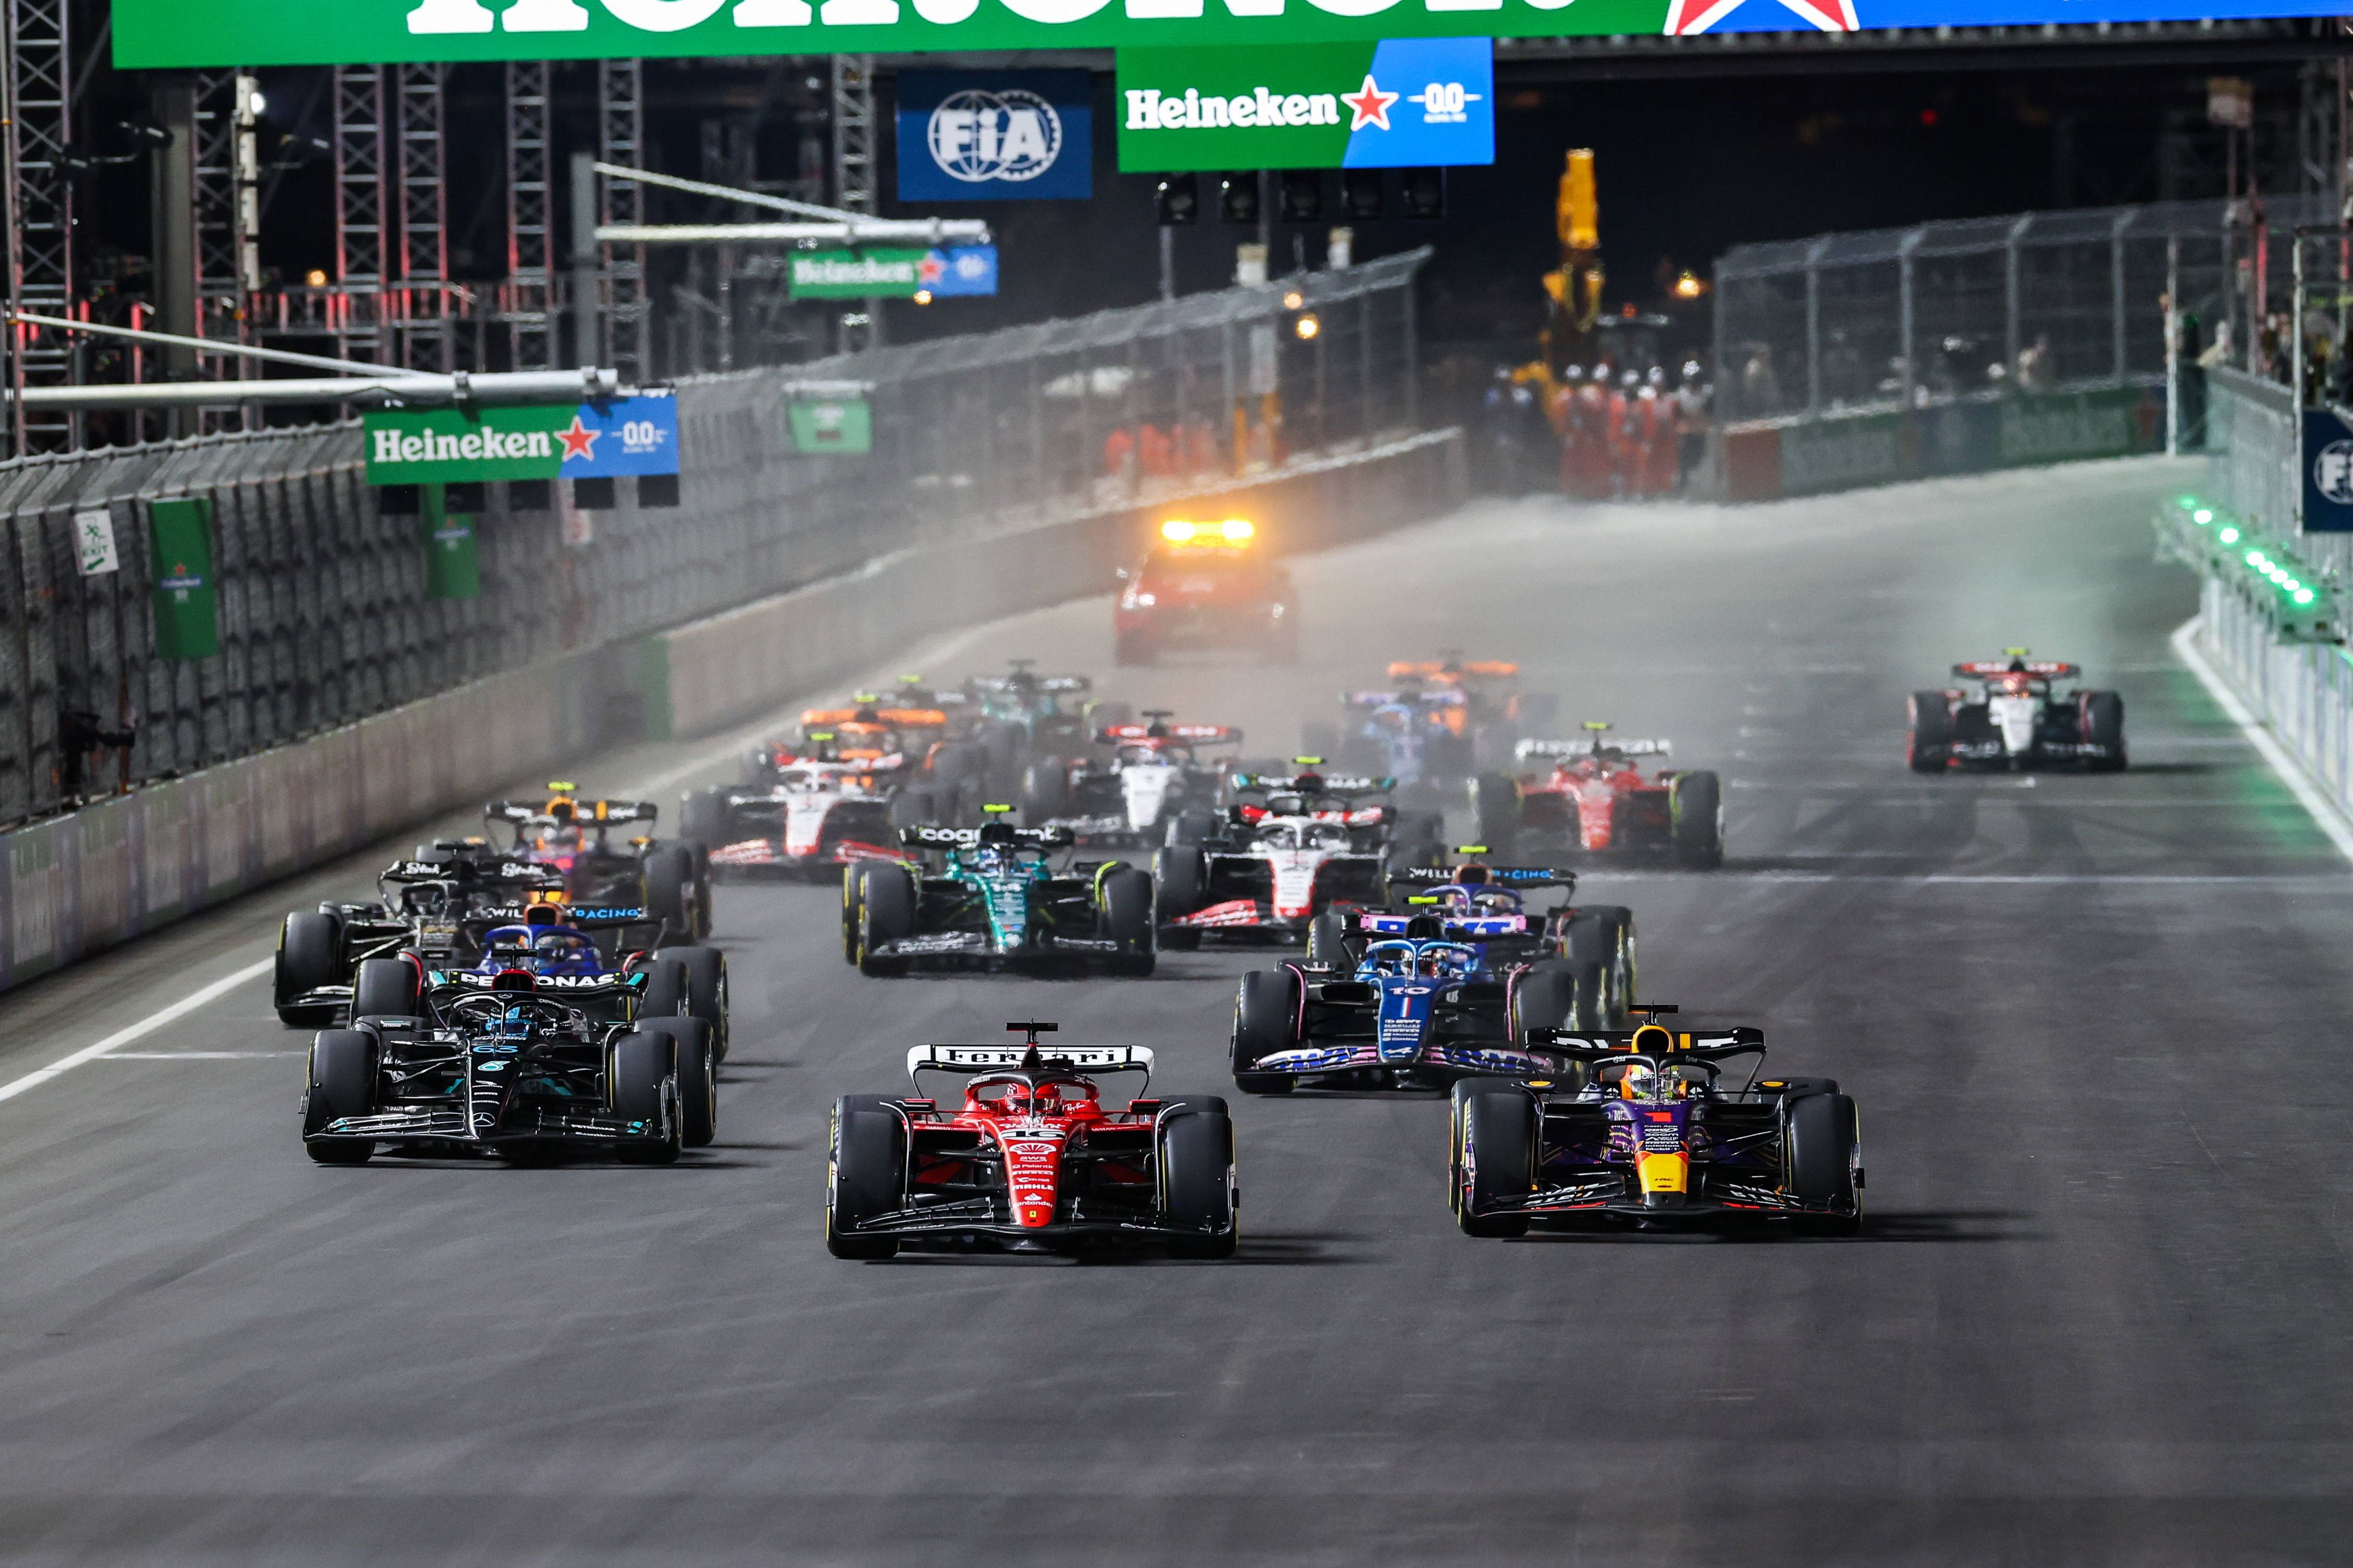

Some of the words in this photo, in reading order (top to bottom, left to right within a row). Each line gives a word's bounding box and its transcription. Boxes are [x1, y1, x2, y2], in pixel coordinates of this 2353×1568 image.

[1125, 86, 1340, 130] Heineken
[373, 426, 552, 463] Heineken
[461, 972, 614, 987] PEONAS
[1389, 986, 1432, 995] 10
[473, 1045, 518, 1053] 63
